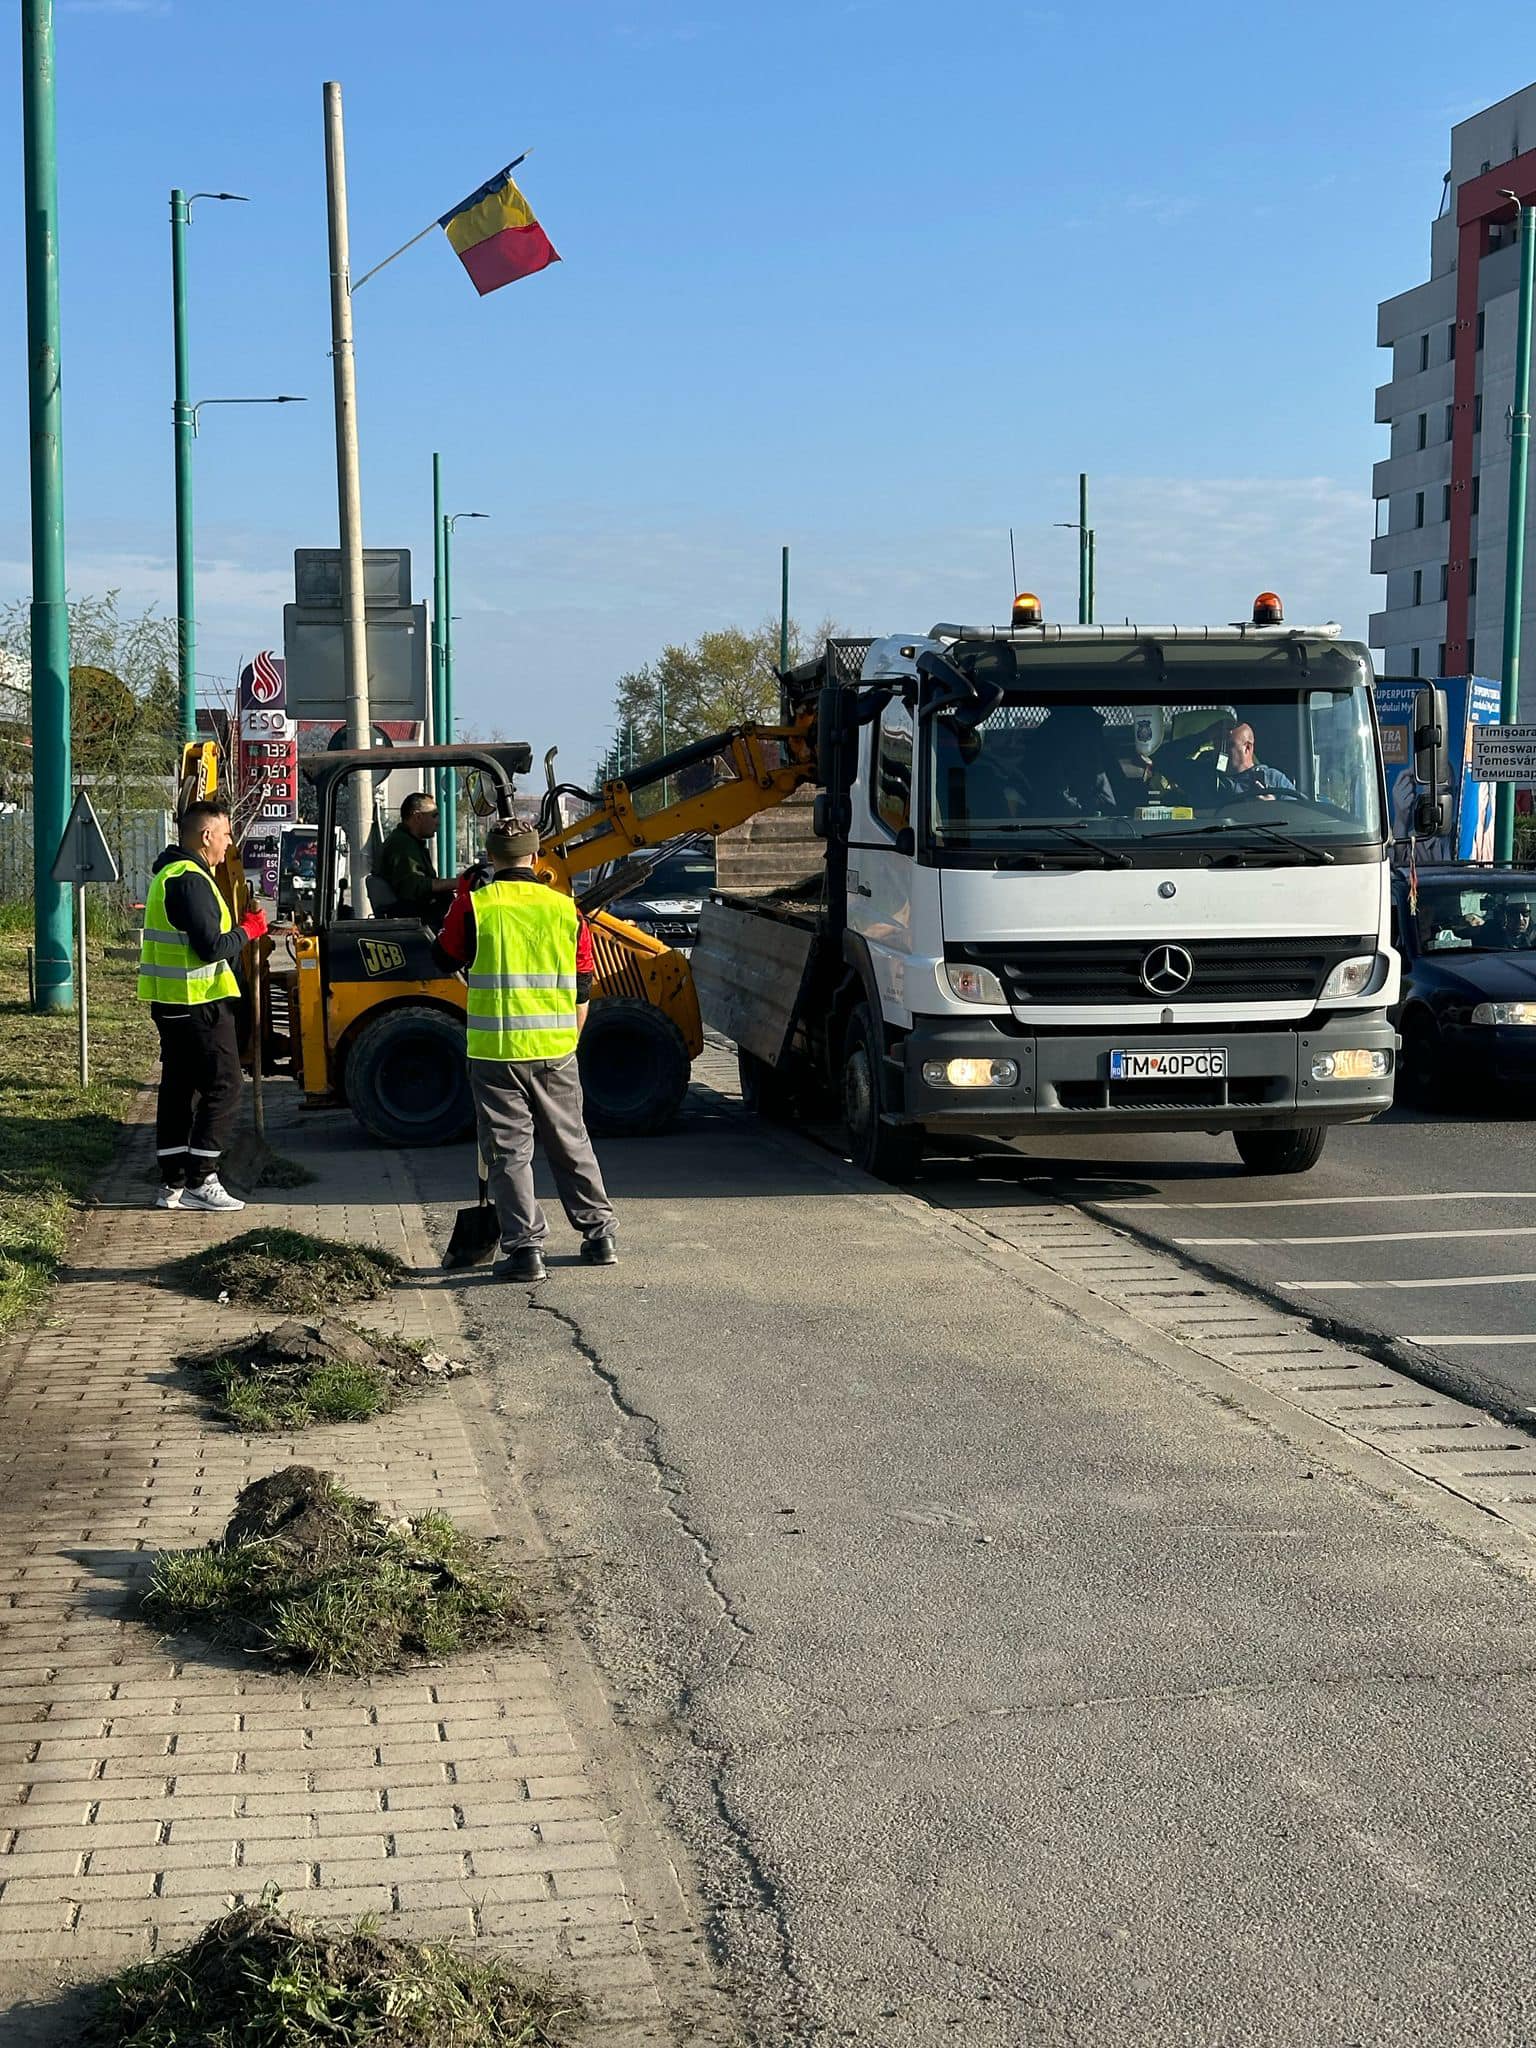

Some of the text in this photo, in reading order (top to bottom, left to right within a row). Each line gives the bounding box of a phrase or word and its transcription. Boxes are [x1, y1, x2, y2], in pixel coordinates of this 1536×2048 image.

[1374, 688, 1416, 699] UPERPUTE
[249, 713, 285, 730] ESO
[1476, 743, 1536, 754] Temeswar
[1477, 754, 1536, 766] Temesvár
[1475, 767, 1536, 780] Темишвар
[365, 942, 402, 972] JCB
